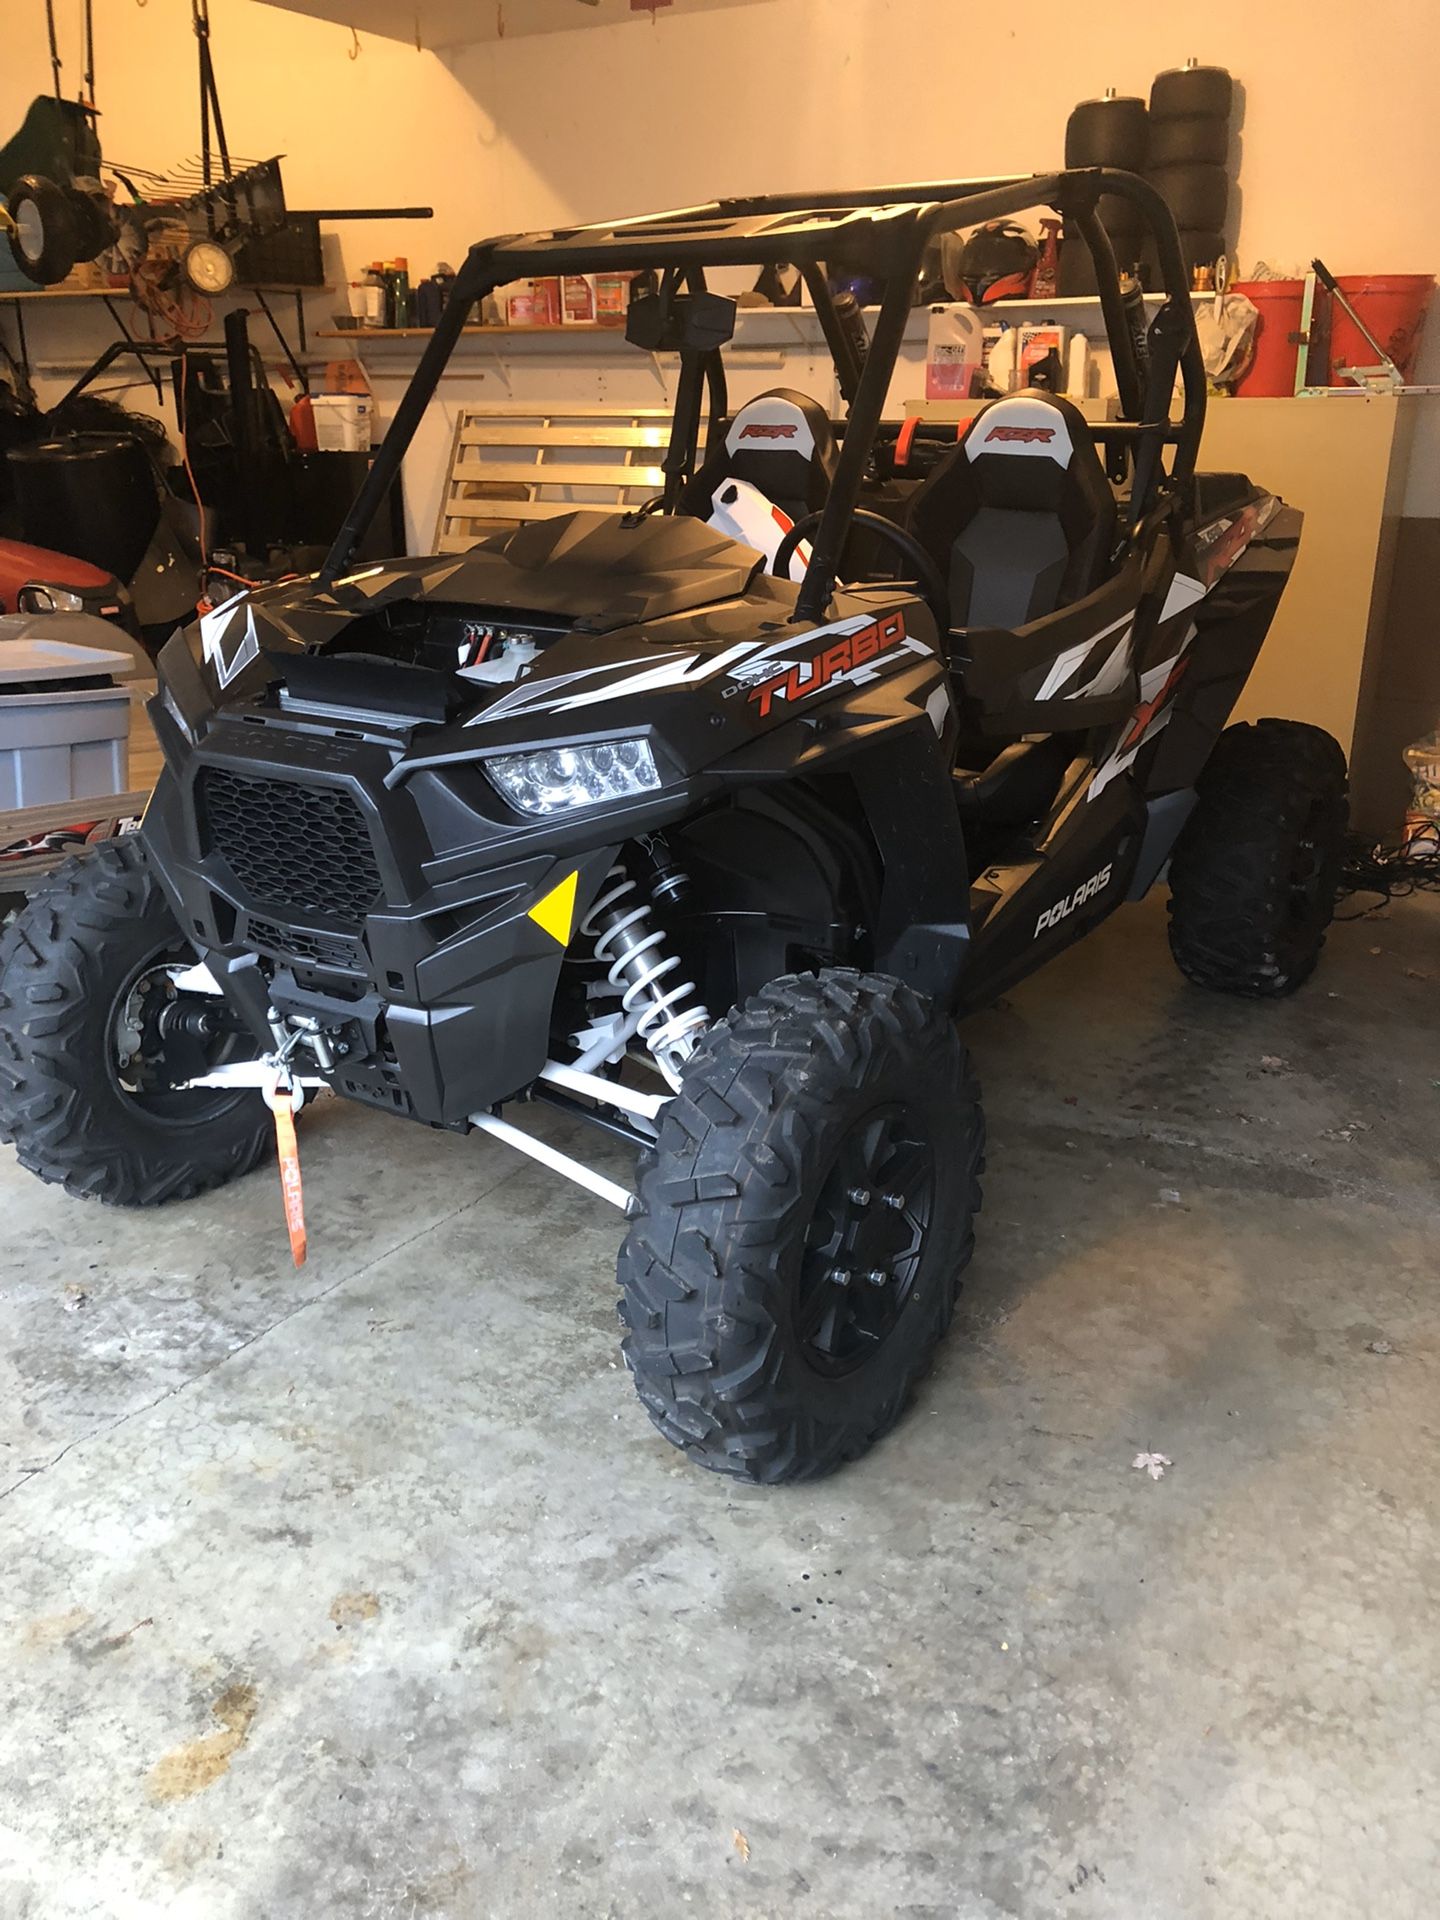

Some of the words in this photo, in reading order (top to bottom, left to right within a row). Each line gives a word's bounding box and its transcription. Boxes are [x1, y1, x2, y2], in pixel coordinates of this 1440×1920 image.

[721, 661, 783, 699] DOHC
[748, 611, 906, 717] TURBO
[1033, 862, 1112, 939] POLARIS
[282, 1156, 304, 1232] POLARIS
